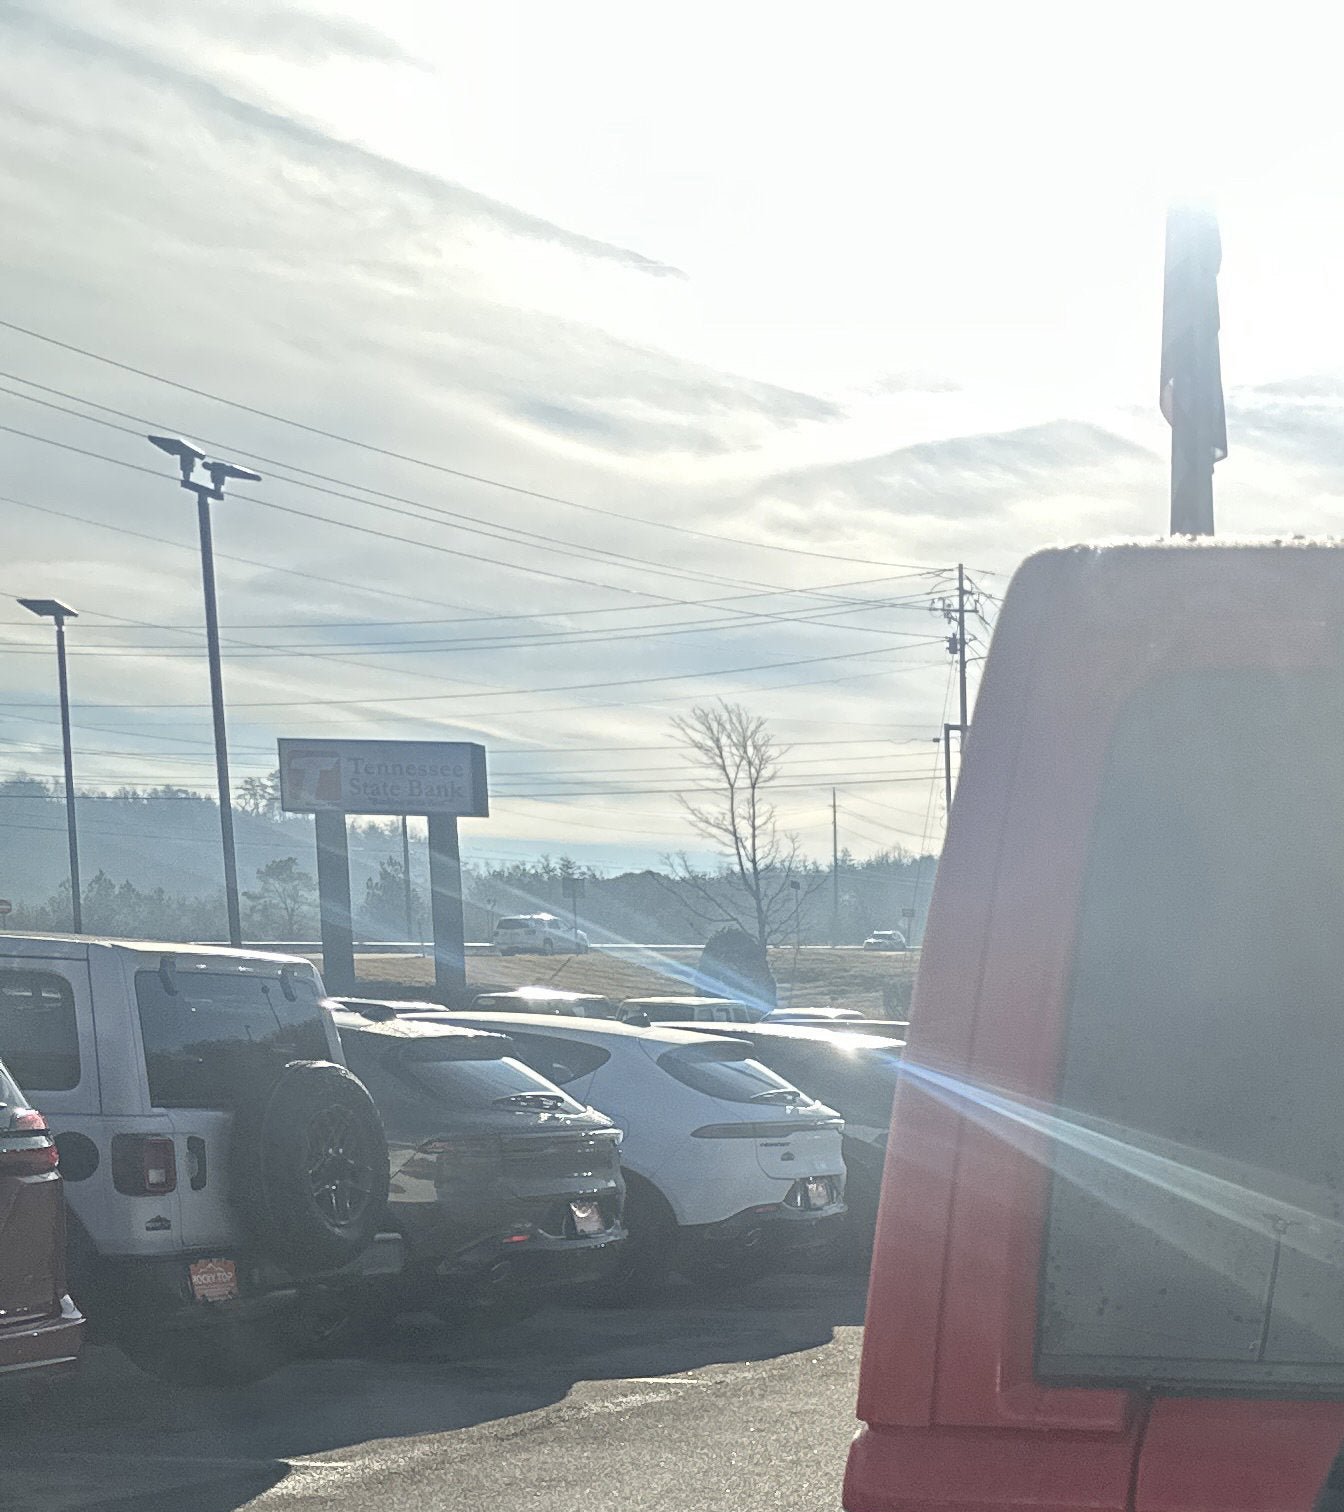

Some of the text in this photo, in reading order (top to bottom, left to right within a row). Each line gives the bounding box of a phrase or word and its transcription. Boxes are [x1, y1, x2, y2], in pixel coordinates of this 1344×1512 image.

[347, 758, 464, 777] Tennessee
[348, 777, 467, 798] State Bank
